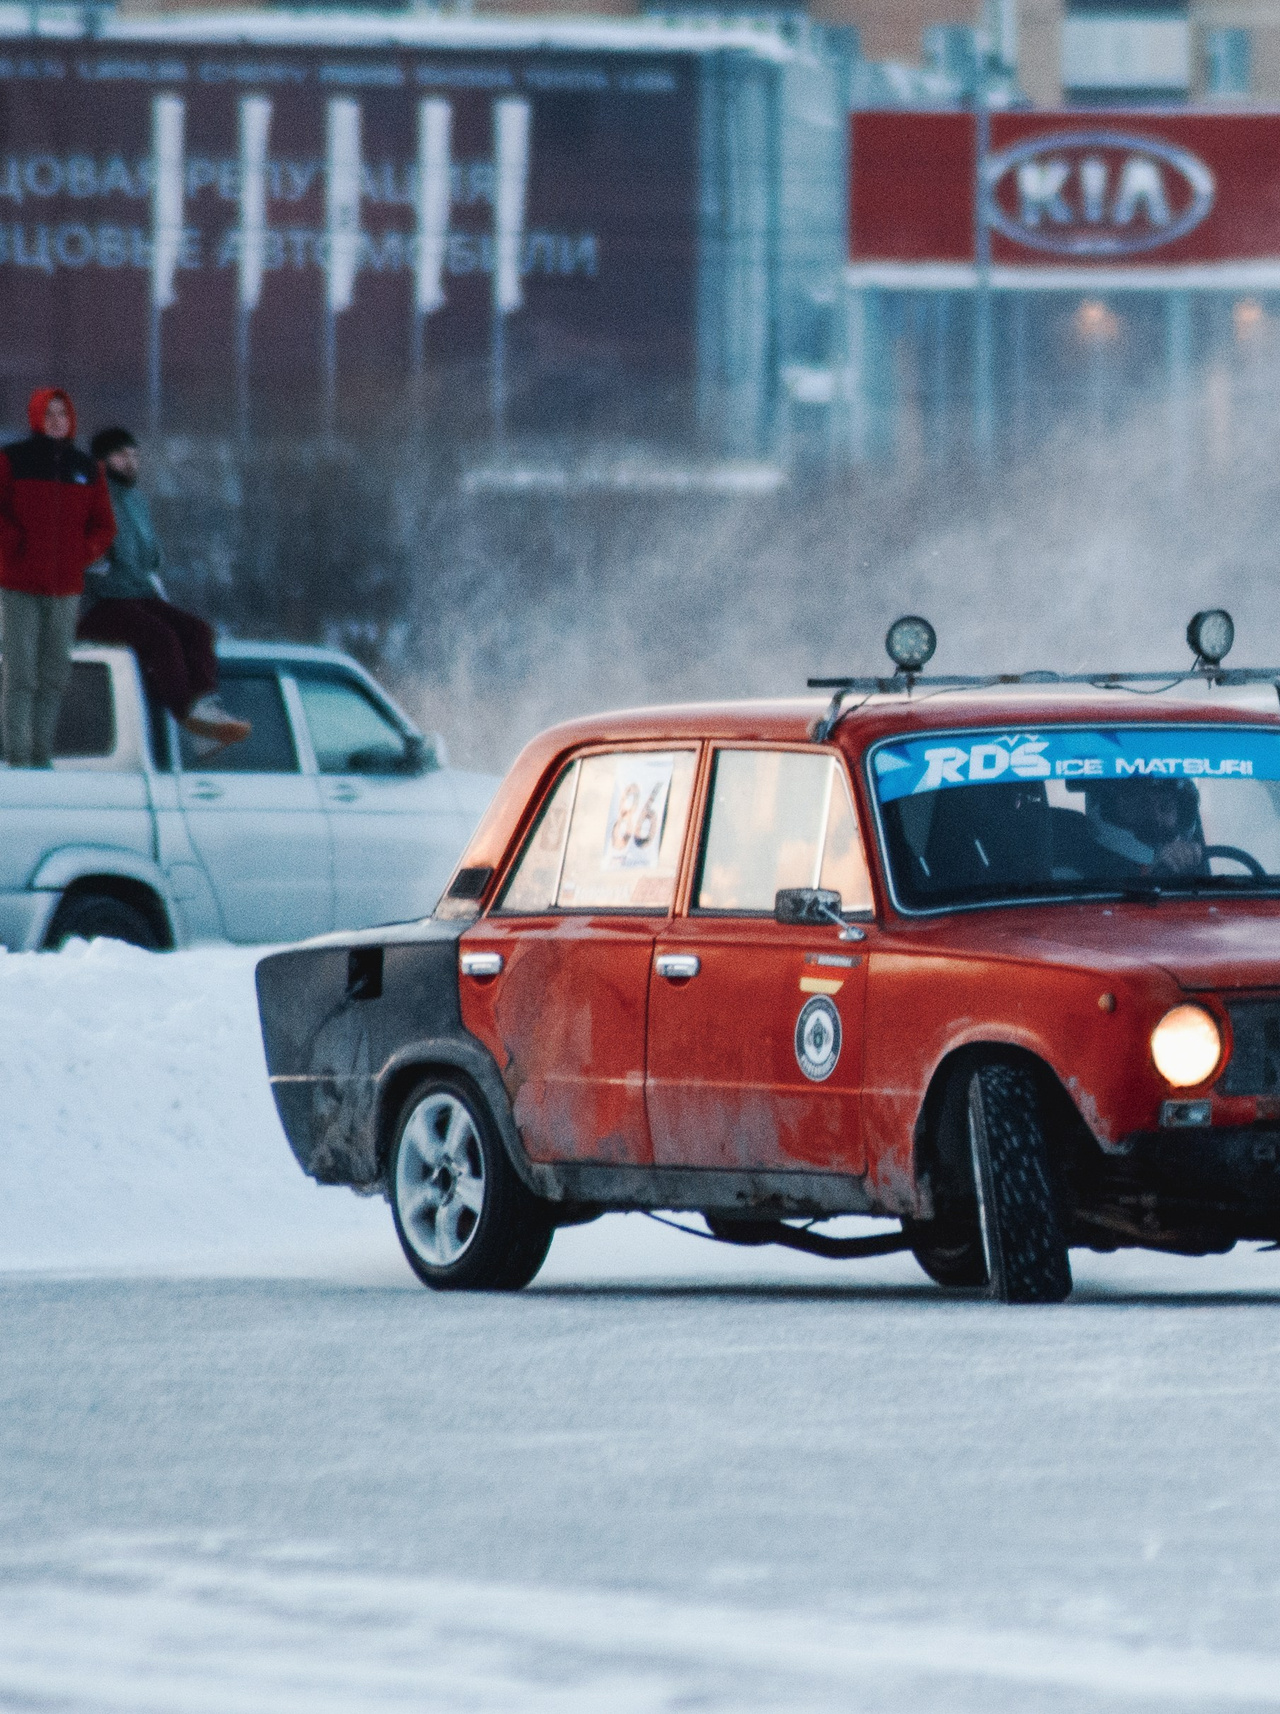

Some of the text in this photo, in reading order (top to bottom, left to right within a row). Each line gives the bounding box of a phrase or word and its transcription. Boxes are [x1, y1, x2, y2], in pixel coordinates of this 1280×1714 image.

[184, 158, 504, 205] РЕПУАЦЯ
[1018, 160, 1171, 226] KIA
[923, 738, 1253, 788] RDS ICE MATSURI
